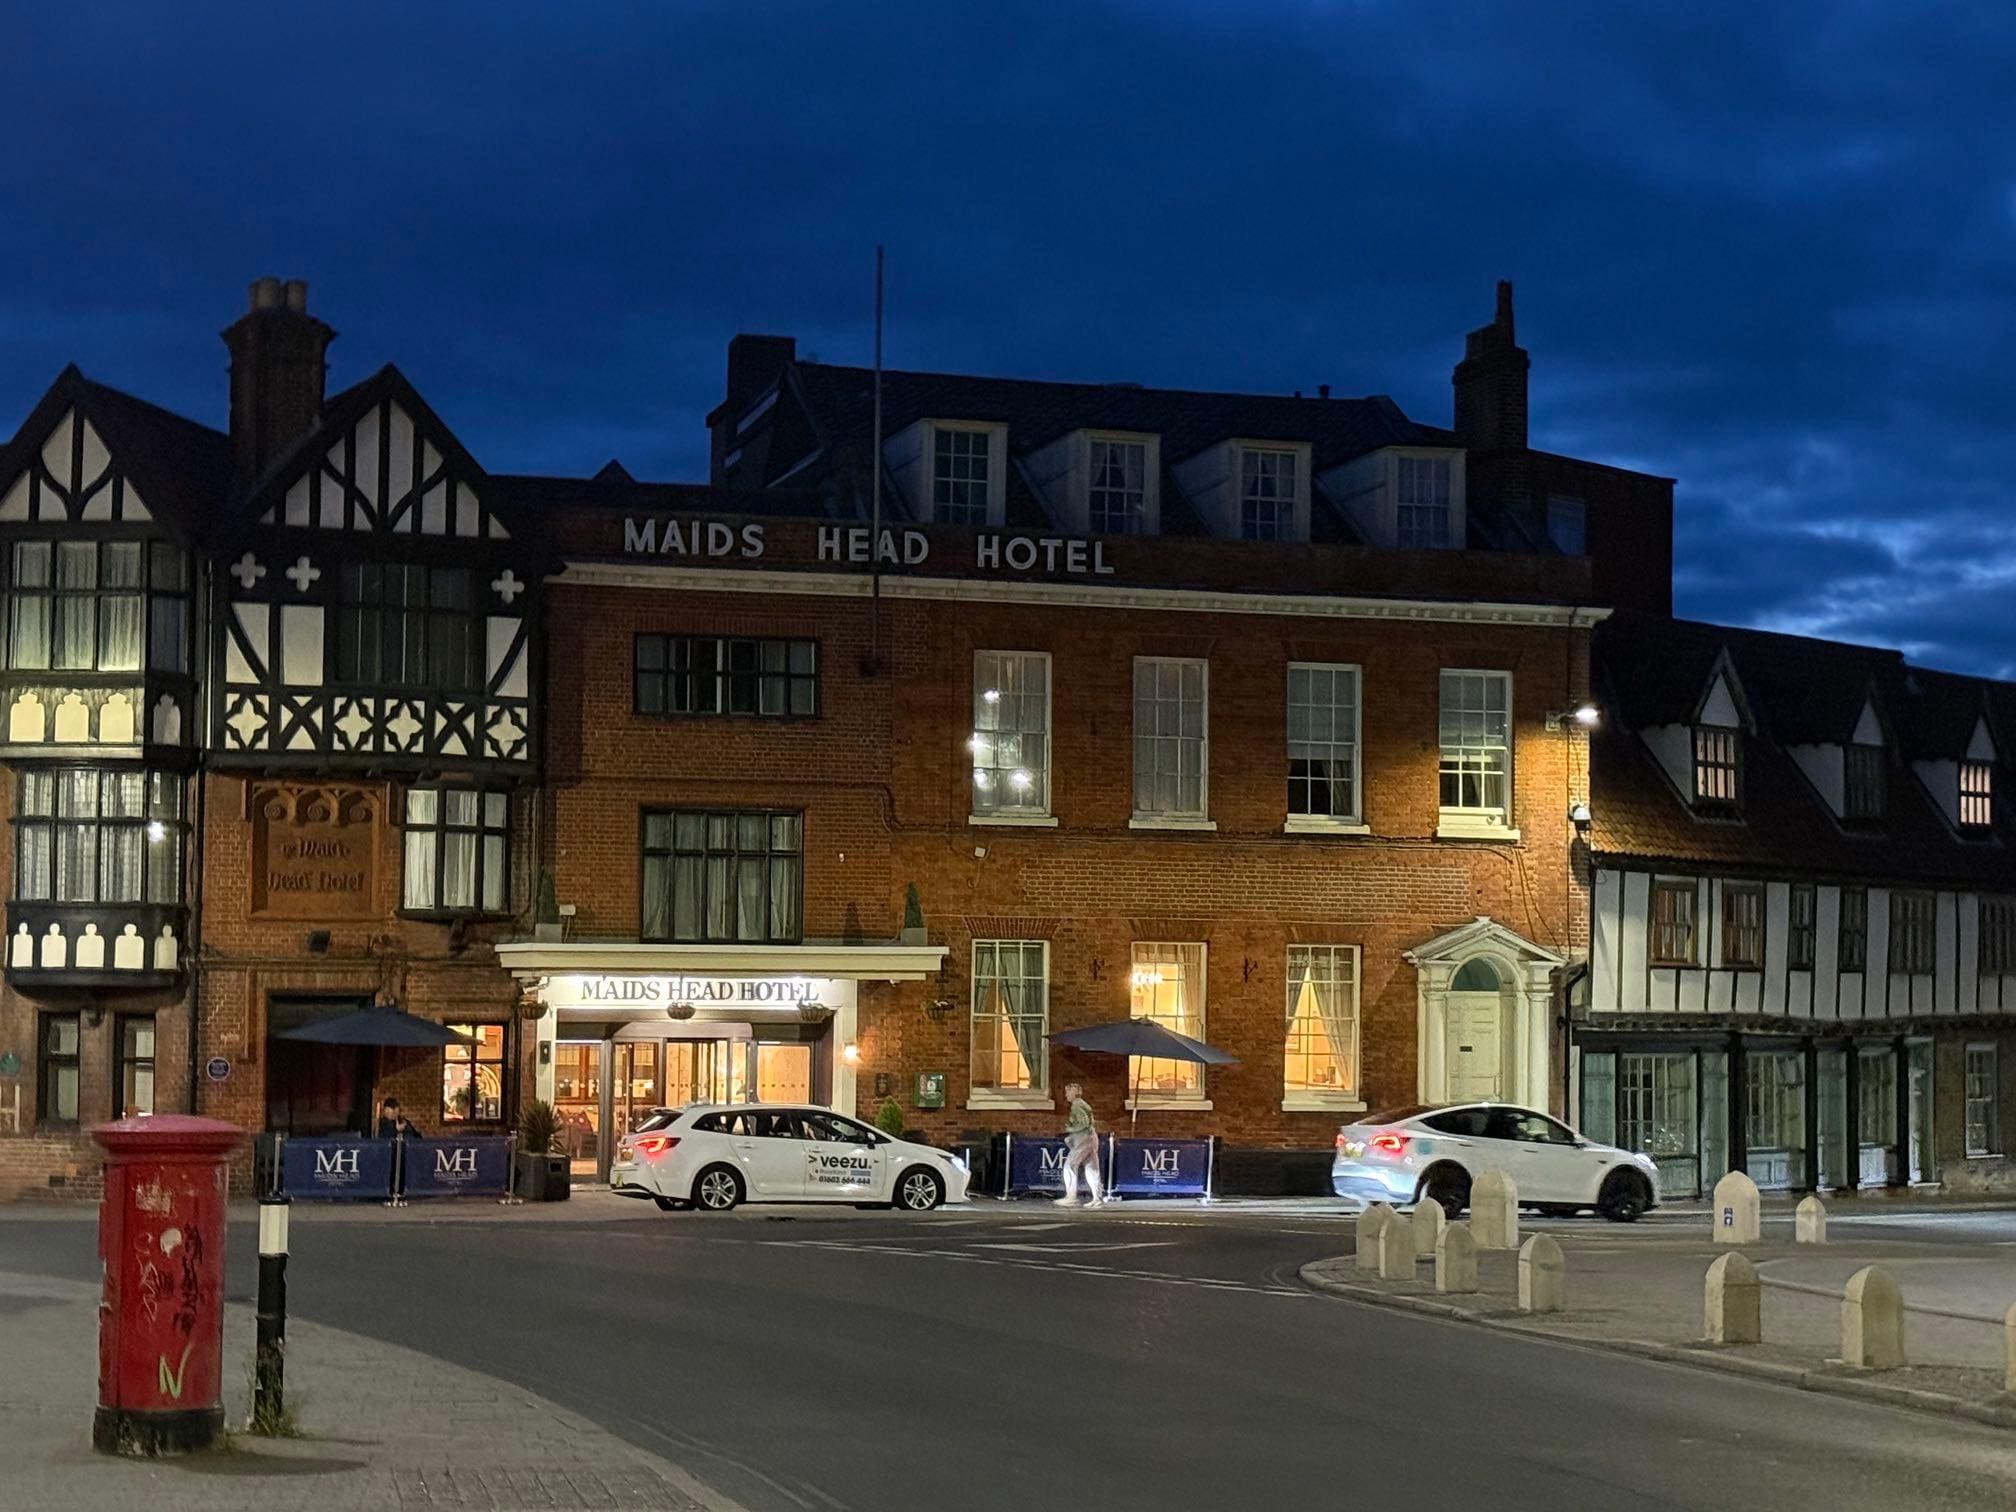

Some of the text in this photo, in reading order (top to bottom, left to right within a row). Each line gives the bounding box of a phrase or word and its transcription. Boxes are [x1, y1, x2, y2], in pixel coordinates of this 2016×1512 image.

[624, 517, 1115, 575] MAIDS HEAD HOTEL
[581, 980, 819, 1002] MAIDS HEAD HOTEL
[314, 1149, 360, 1173] MH
[434, 1148, 478, 1172] MH
[1142, 1148, 1180, 1171] MH
